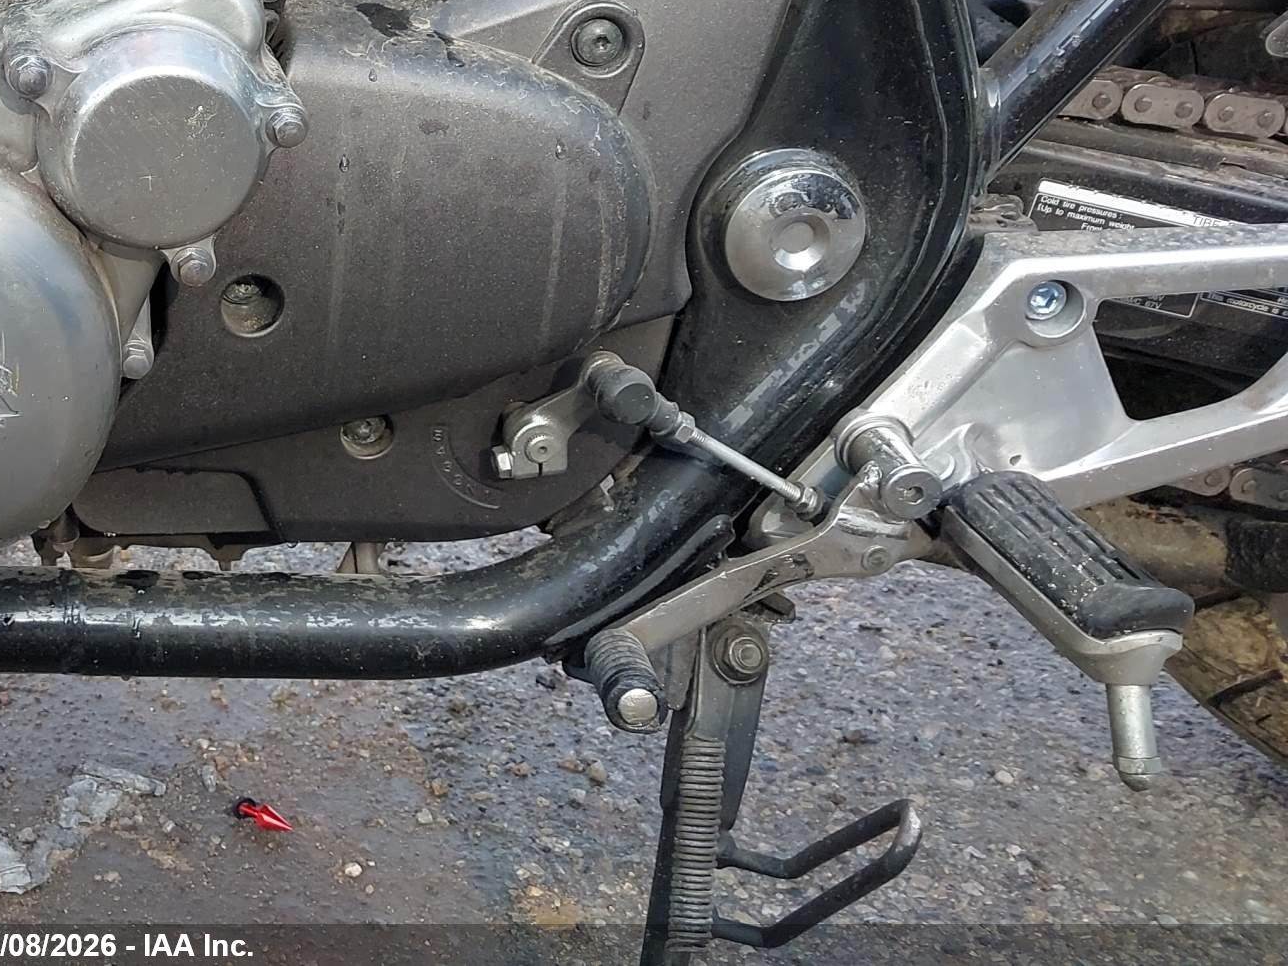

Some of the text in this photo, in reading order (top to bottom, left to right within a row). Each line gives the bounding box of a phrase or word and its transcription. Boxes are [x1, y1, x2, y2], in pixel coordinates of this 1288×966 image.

[1041, 195, 1060, 206] Cold
[1055, 208, 1065, 216] to
[1067, 211, 1106, 225] maximum
[1226, 298, 1269, 312] motorcycle
